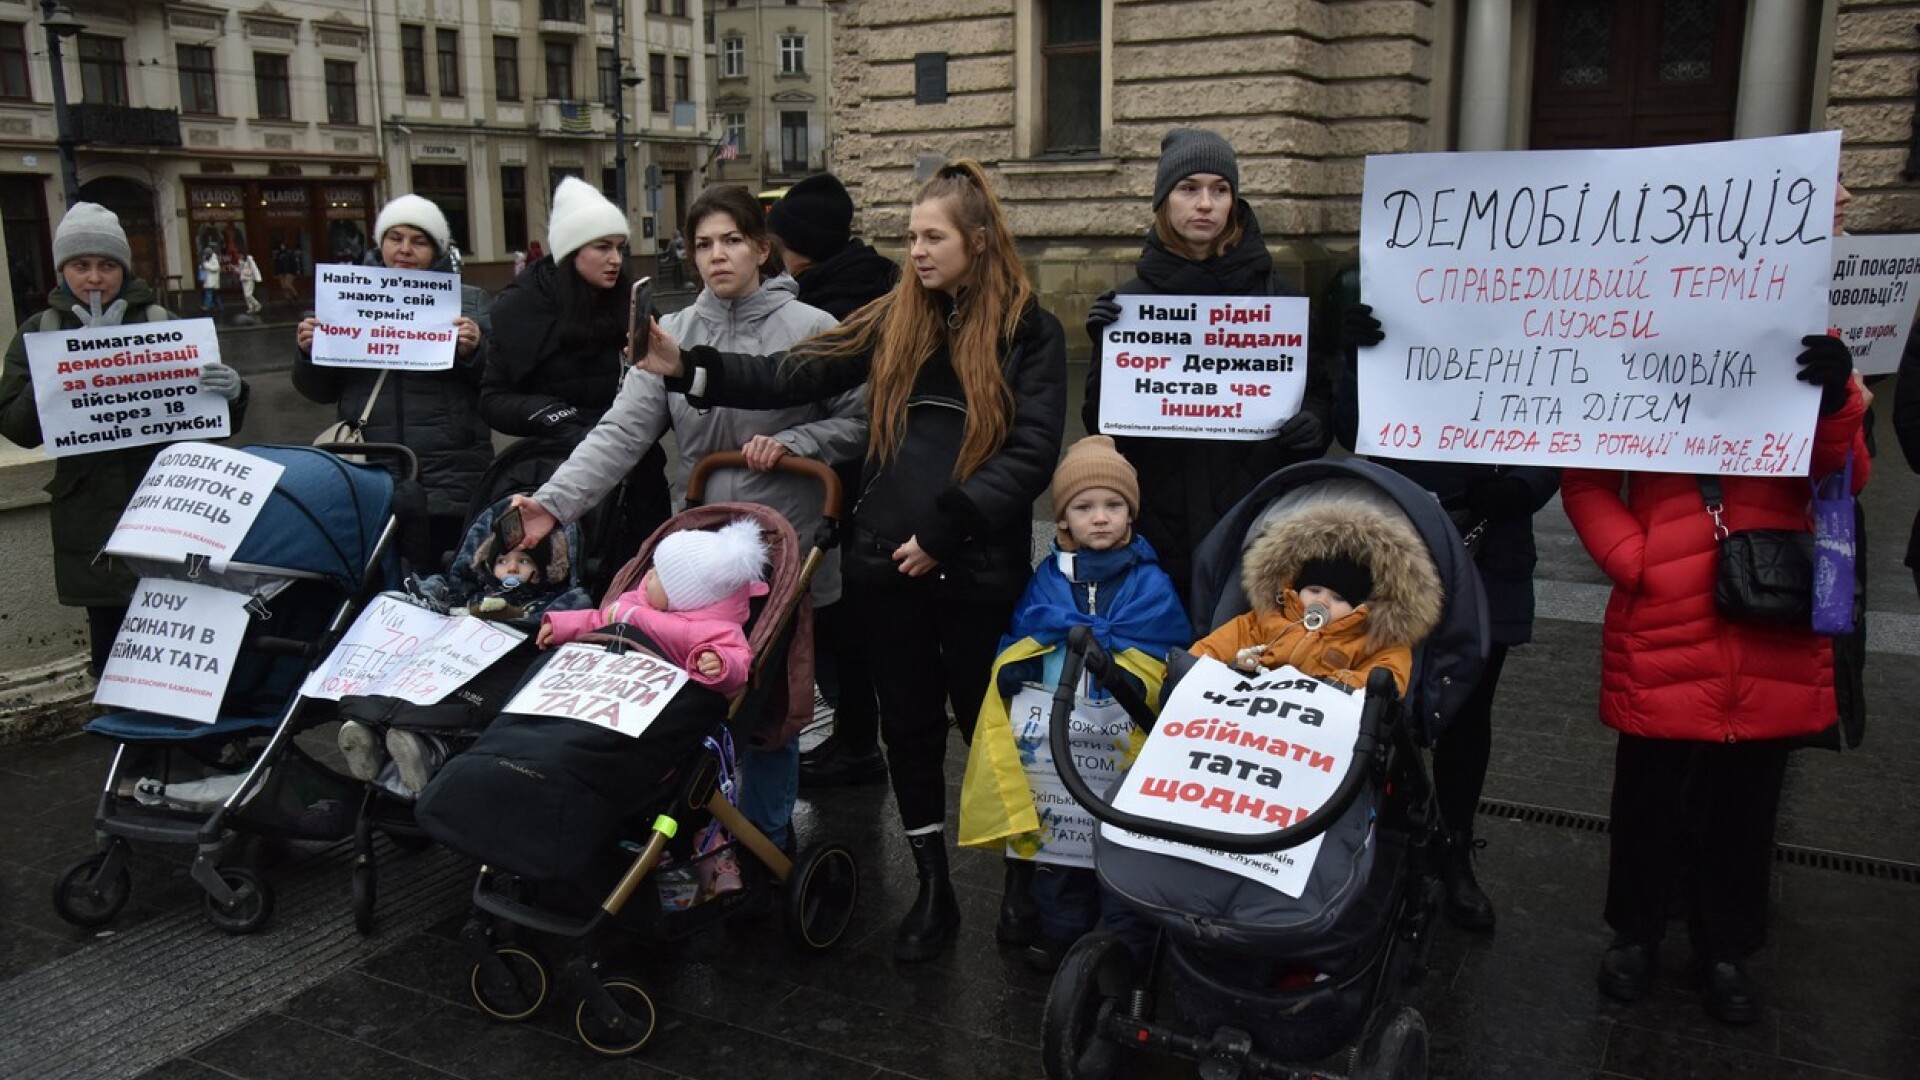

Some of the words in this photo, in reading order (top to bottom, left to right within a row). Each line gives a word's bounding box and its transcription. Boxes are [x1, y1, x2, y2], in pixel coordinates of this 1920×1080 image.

[1383, 169, 1827, 259] ДЕМОБІЛІЗАЦІЯ
[323, 272, 372, 285] Навіть
[381, 277, 452, 291] ув'язнені
[1416, 255, 1650, 303] СПРАВЕДЛИВИЙ
[1670, 259, 1790, 301] ТЕРМІН
[338, 291, 395, 303] знають
[403, 294, 435, 306] свій
[357, 309, 414, 321] термін!
[1139, 303, 1197, 321] Наші
[1210, 304, 1270, 325] рідні
[1523, 309, 1660, 339] СЛУЖБИ
[66, 331, 183, 352] Вимагаємо
[320, 323, 361, 339] Чому
[370, 325, 452, 342] військові
[1109, 330, 1192, 345] сповна
[1204, 328, 1302, 348] віддали
[57, 345, 199, 375] демобілізації
[367, 343, 399, 355] НІ?!
[1116, 352, 1171, 372] борг
[1182, 354, 1294, 374] Державі!
[1405, 346, 1589, 386] ПОВЕРНІТЬ
[1621, 349, 1756, 388] ЧОЛОВІКА
[63, 380, 86, 392] за
[92, 367, 200, 388] бажанням
[1135, 378, 1218, 395] Настав
[1230, 383, 1271, 397] час
[72, 385, 197, 409] військового
[1161, 398, 1243, 418] інших!
[1499, 393, 1563, 424] ТАТА
[1582, 393, 1691, 424] ДІТЯМ
[91, 406, 150, 424] через
[164, 400, 185, 415] 18
[55, 425, 132, 448] місяців
[140, 416, 222, 437] служби!
[1379, 423, 1422, 448] 103
[1438, 429, 1541, 455] БРИГАДА
[1548, 432, 1583, 455] БЕЗ
[1597, 430, 1680, 459] РОТАЦІЇ
[1684, 434, 1753, 457] МАЙЖЕ
[222, 462, 252, 481] НЕ
[164, 475, 237, 500] КВИТОК
[238, 491, 253, 507] В
[163, 496, 231, 525] КІНЕЦЬ
[141, 591, 188, 611] ХОЧУ
[200, 628, 216, 644] В
[169, 649, 219, 674] ТАТА
[549, 650, 605, 673] МОЯ
[603, 655, 678, 690] ЧЕРГА
[539, 672, 660, 707] ОБІЙМАТИ
[533, 692, 620, 727] ТАТА
[1029, 706, 1042, 721] Я
[1203, 691, 1325, 728] черга
[1163, 717, 1336, 774] обіймати
[1188, 750, 1283, 789] тата
